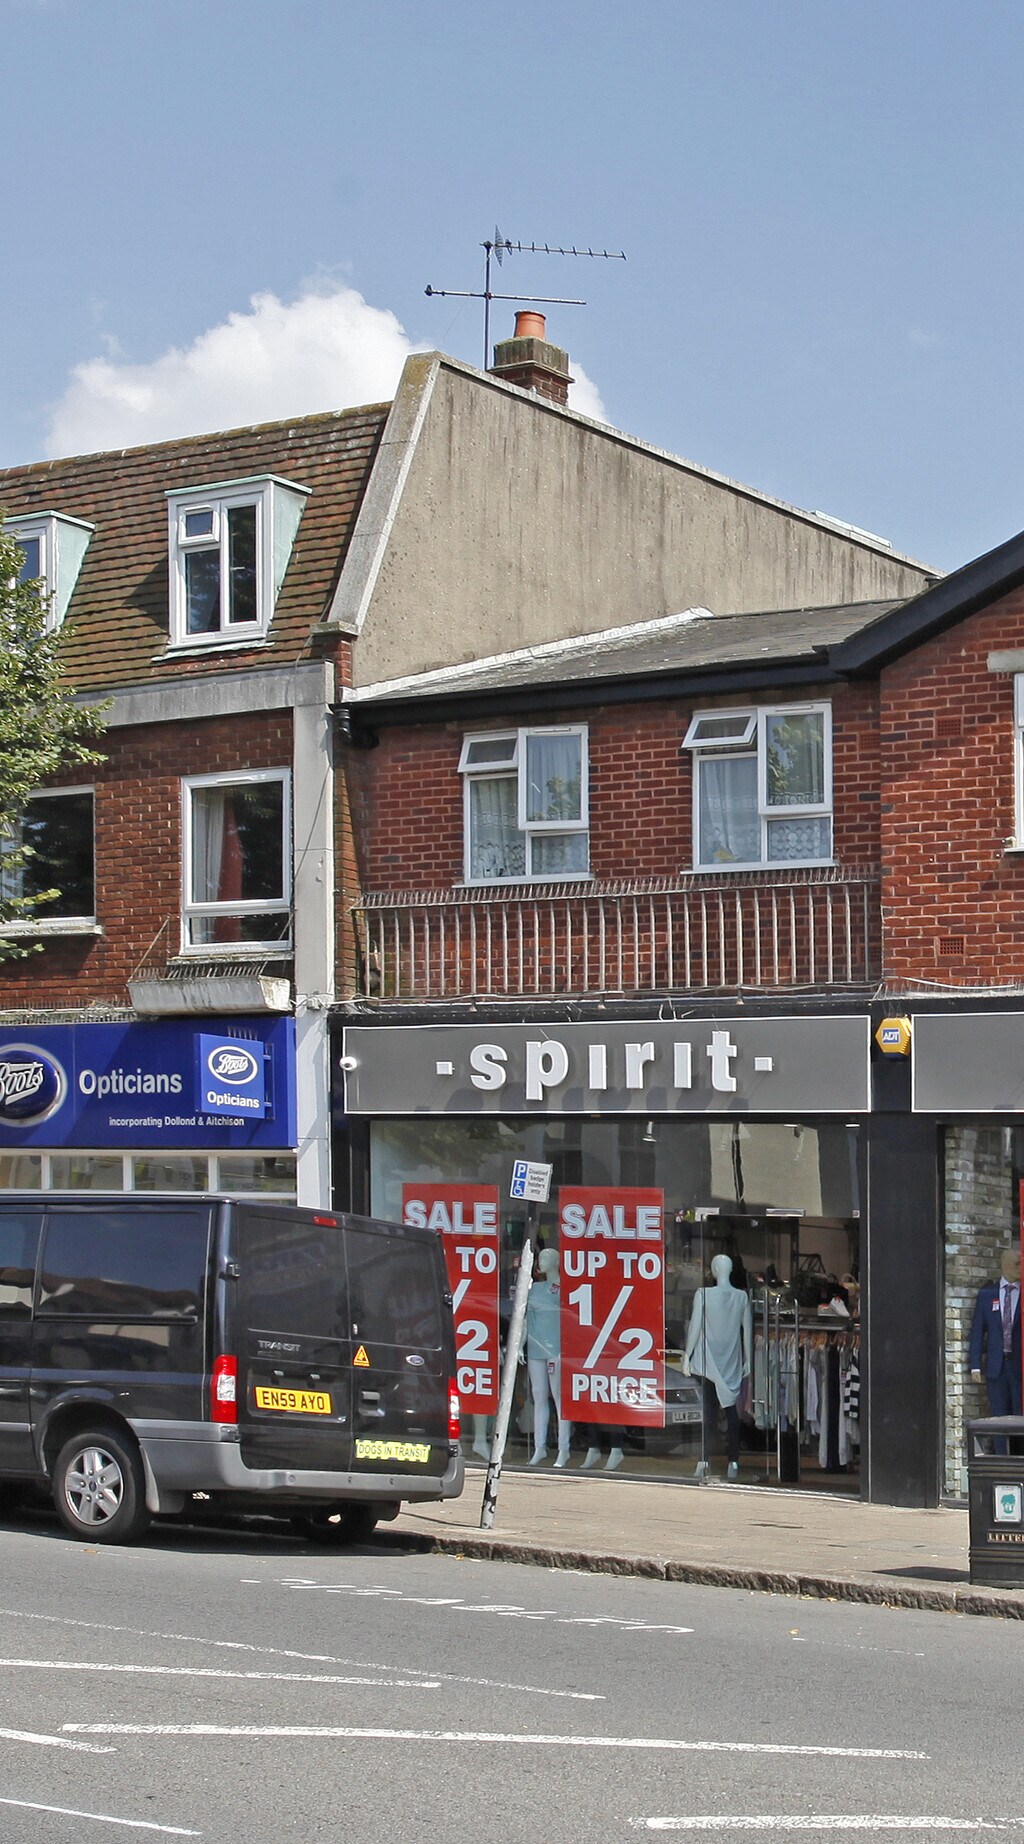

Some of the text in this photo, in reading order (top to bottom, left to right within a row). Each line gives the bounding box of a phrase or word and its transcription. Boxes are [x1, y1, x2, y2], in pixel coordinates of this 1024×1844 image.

[883, 1031, 899, 1041] ADT
[215, 1053, 248, 1074] Boots
[79, 1068, 183, 1098] Opticians
[206, 1091, 260, 1109] Opticians
[109, 1116, 244, 1127] incorporating Dollond & Aitchison
[517, 1164, 526, 1177] P
[404, 1200, 497, 1235] SALE
[561, 1203, 663, 1240] SALE
[455, 1246, 497, 1274] TO
[563, 1250, 662, 1281] UP TO
[568, 1284, 654, 1371] 1/2
[257, 1340, 302, 1352] TRANSIT
[571, 1373, 658, 1404] PRICE
[262, 1390, 325, 1410] EN59 AYO
[359, 1444, 427, 1458] DOGS IN TRANSIT
